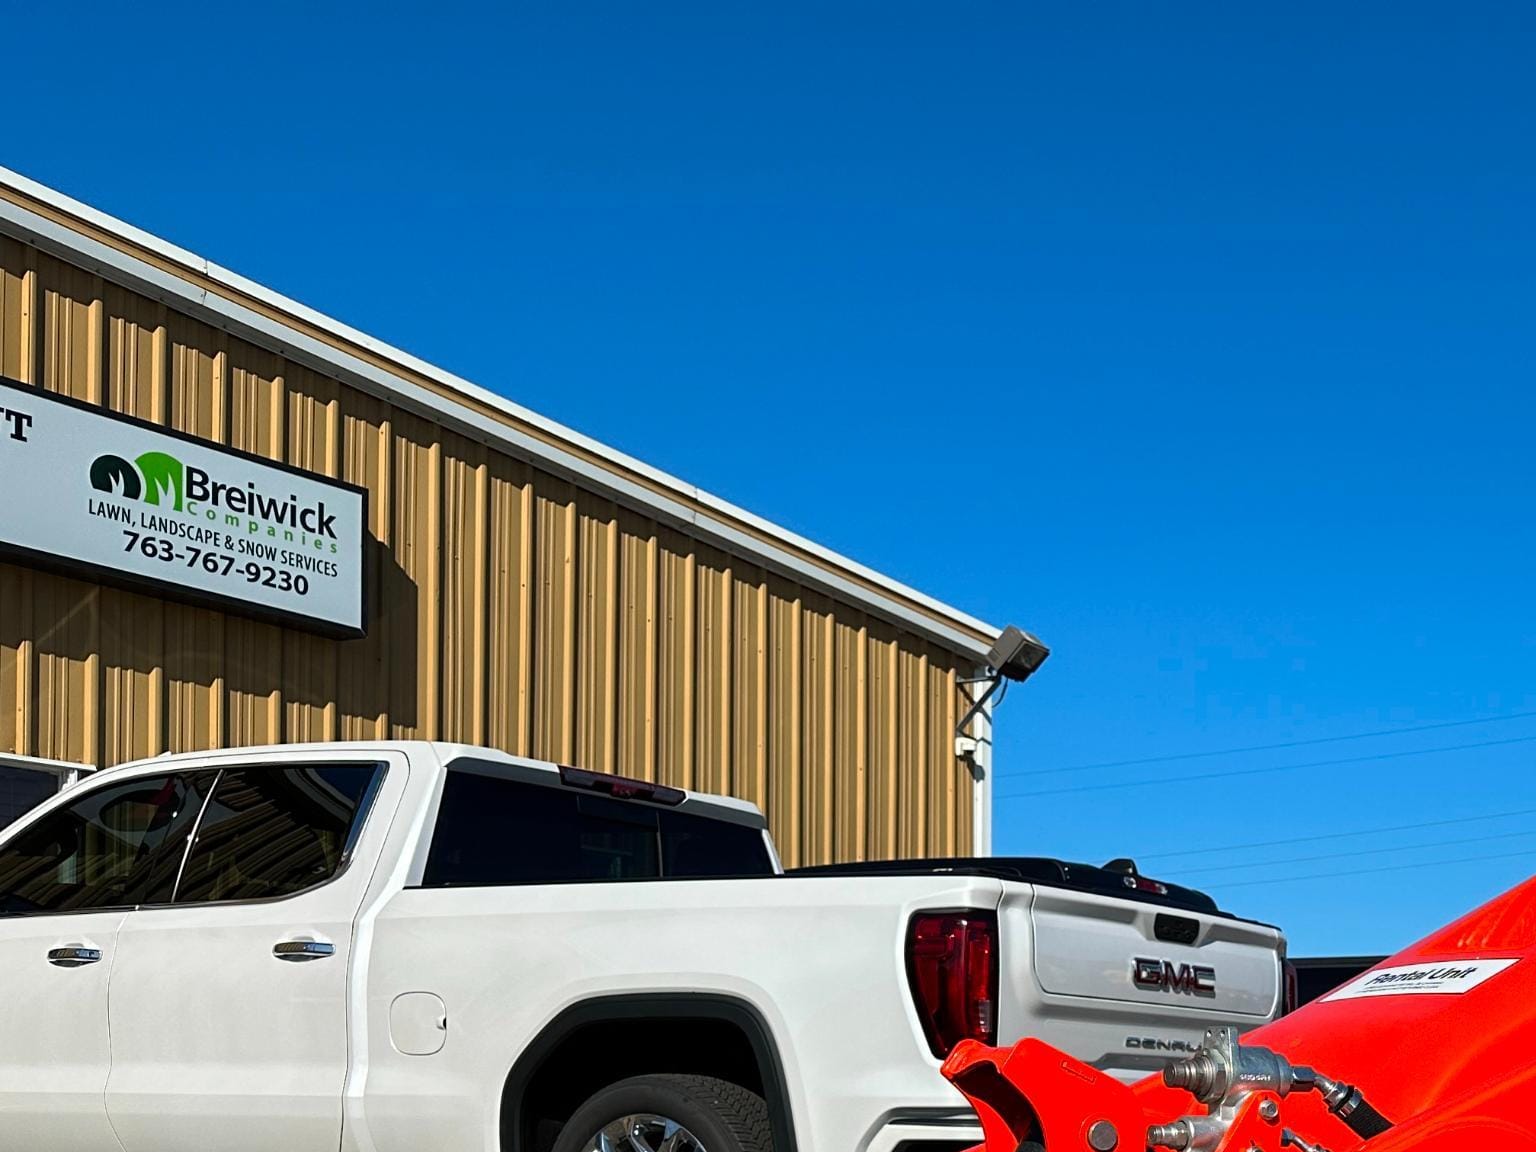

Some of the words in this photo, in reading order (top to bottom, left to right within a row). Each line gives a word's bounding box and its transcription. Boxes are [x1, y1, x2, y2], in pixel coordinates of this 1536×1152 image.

[0, 406, 32, 443] T
[186, 465, 338, 540] Breiwick
[187, 501, 338, 554] Companies
[88, 498, 136, 528] LAWN,
[141, 512, 220, 548] LANDSCAPE
[224, 535, 235, 551] &
[238, 538, 278, 562] SNOW
[280, 549, 338, 577] SERVICES
[122, 529, 309, 596] 763-767-9230
[1131, 957, 1216, 999] GMC
[1364, 968, 1432, 986] Rental
[1428, 965, 1479, 980] Unit
